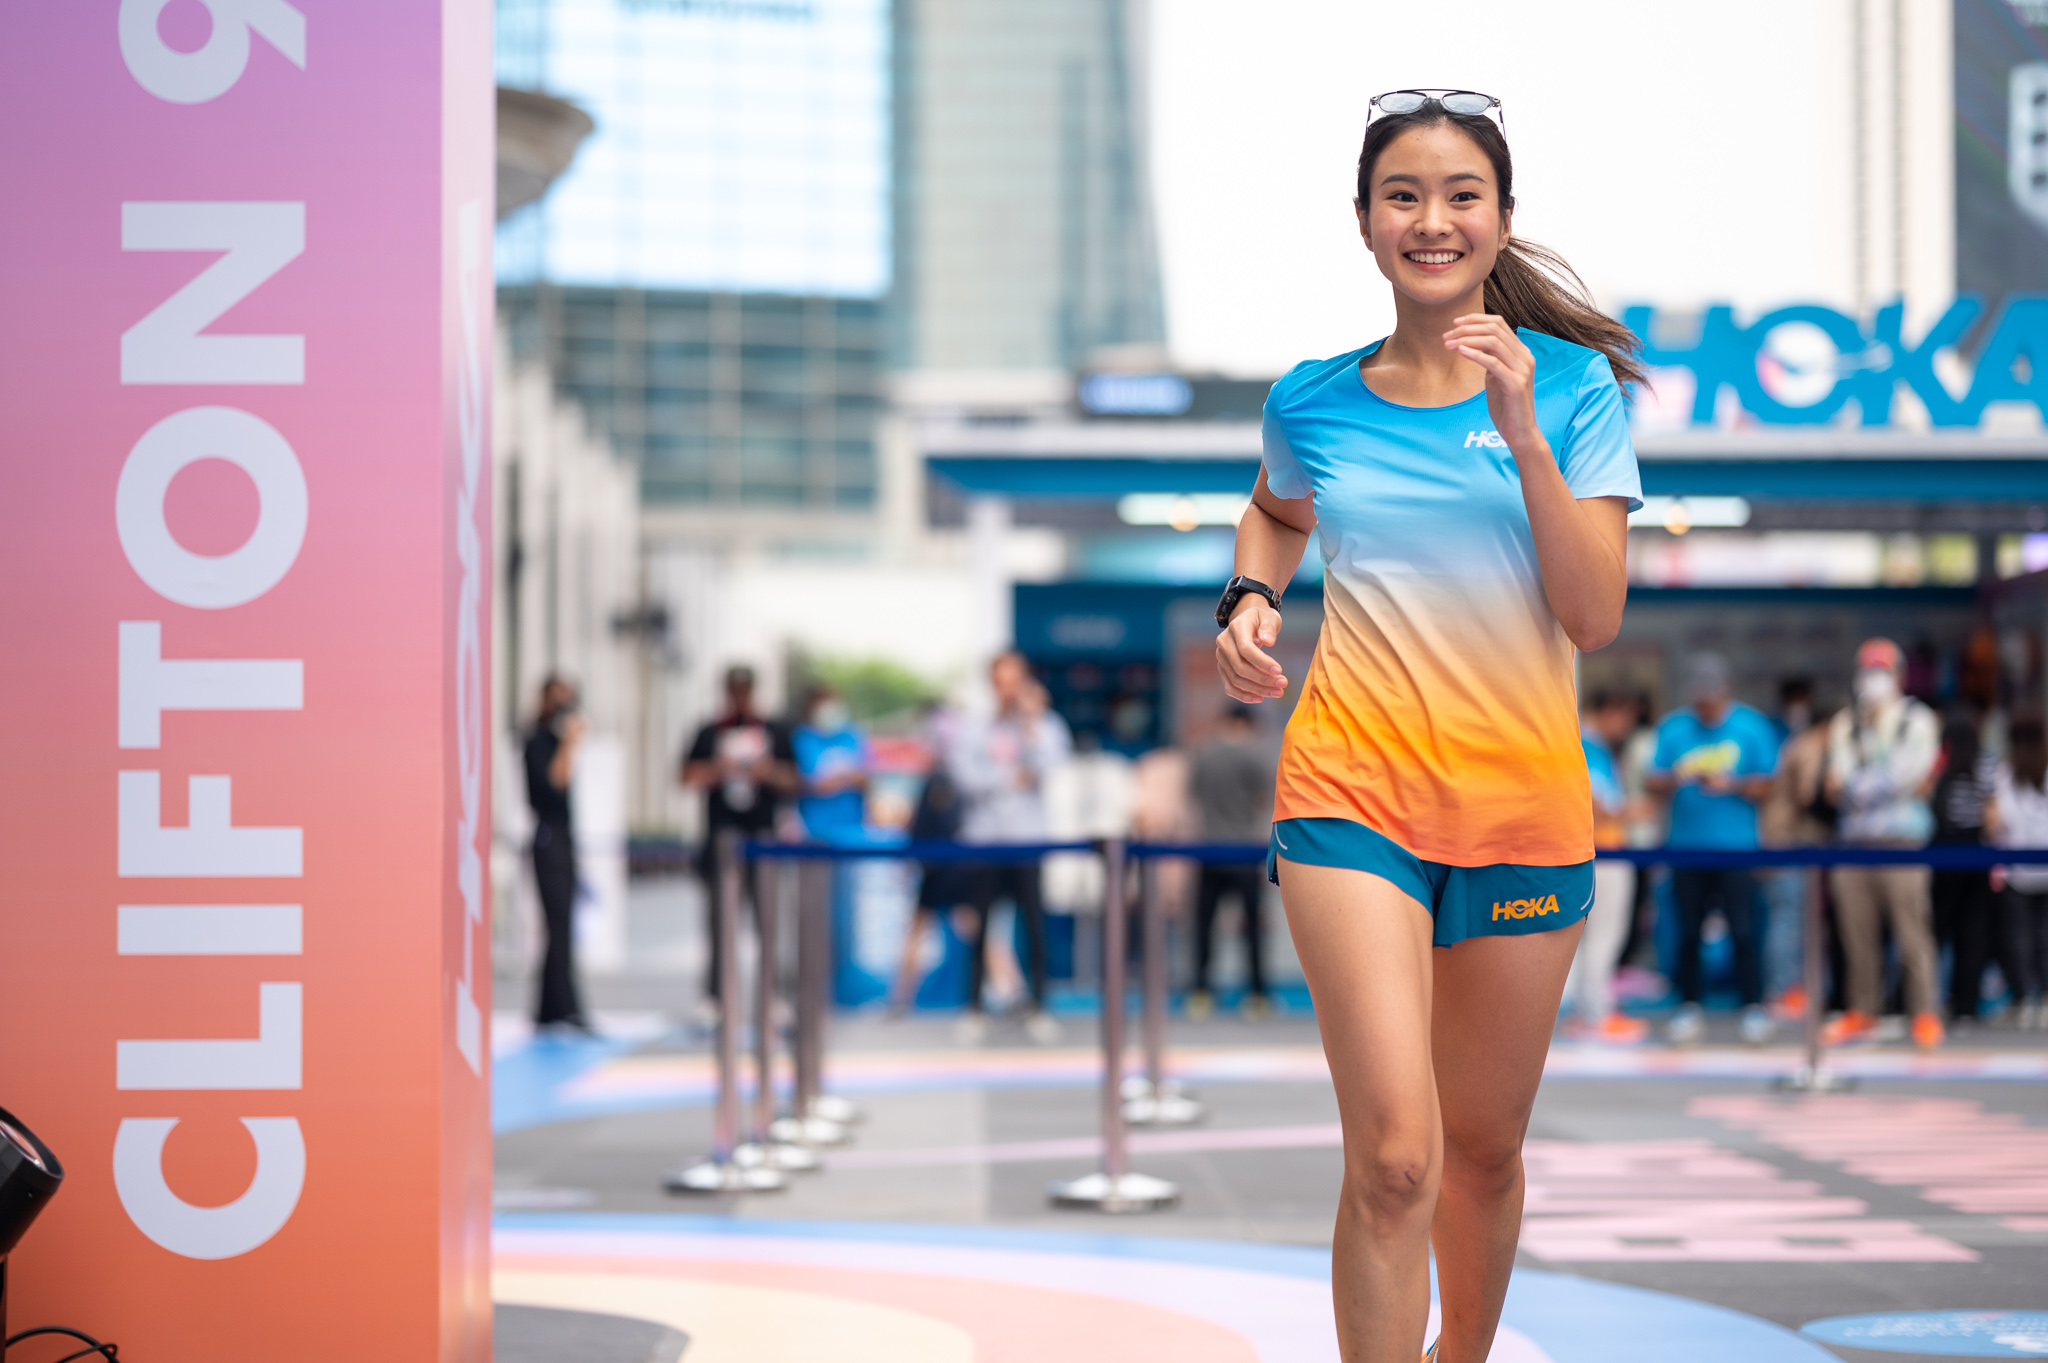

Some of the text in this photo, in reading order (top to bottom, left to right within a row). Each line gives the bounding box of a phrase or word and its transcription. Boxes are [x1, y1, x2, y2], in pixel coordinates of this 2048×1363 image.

[1620, 297, 2048, 426] HOKA
[1463, 430, 1508, 448] HO
[113, 0, 308, 1260] CLIFTON 9
[457, 199, 482, 1076] HOKA
[1492, 894, 1560, 921] HOKA
